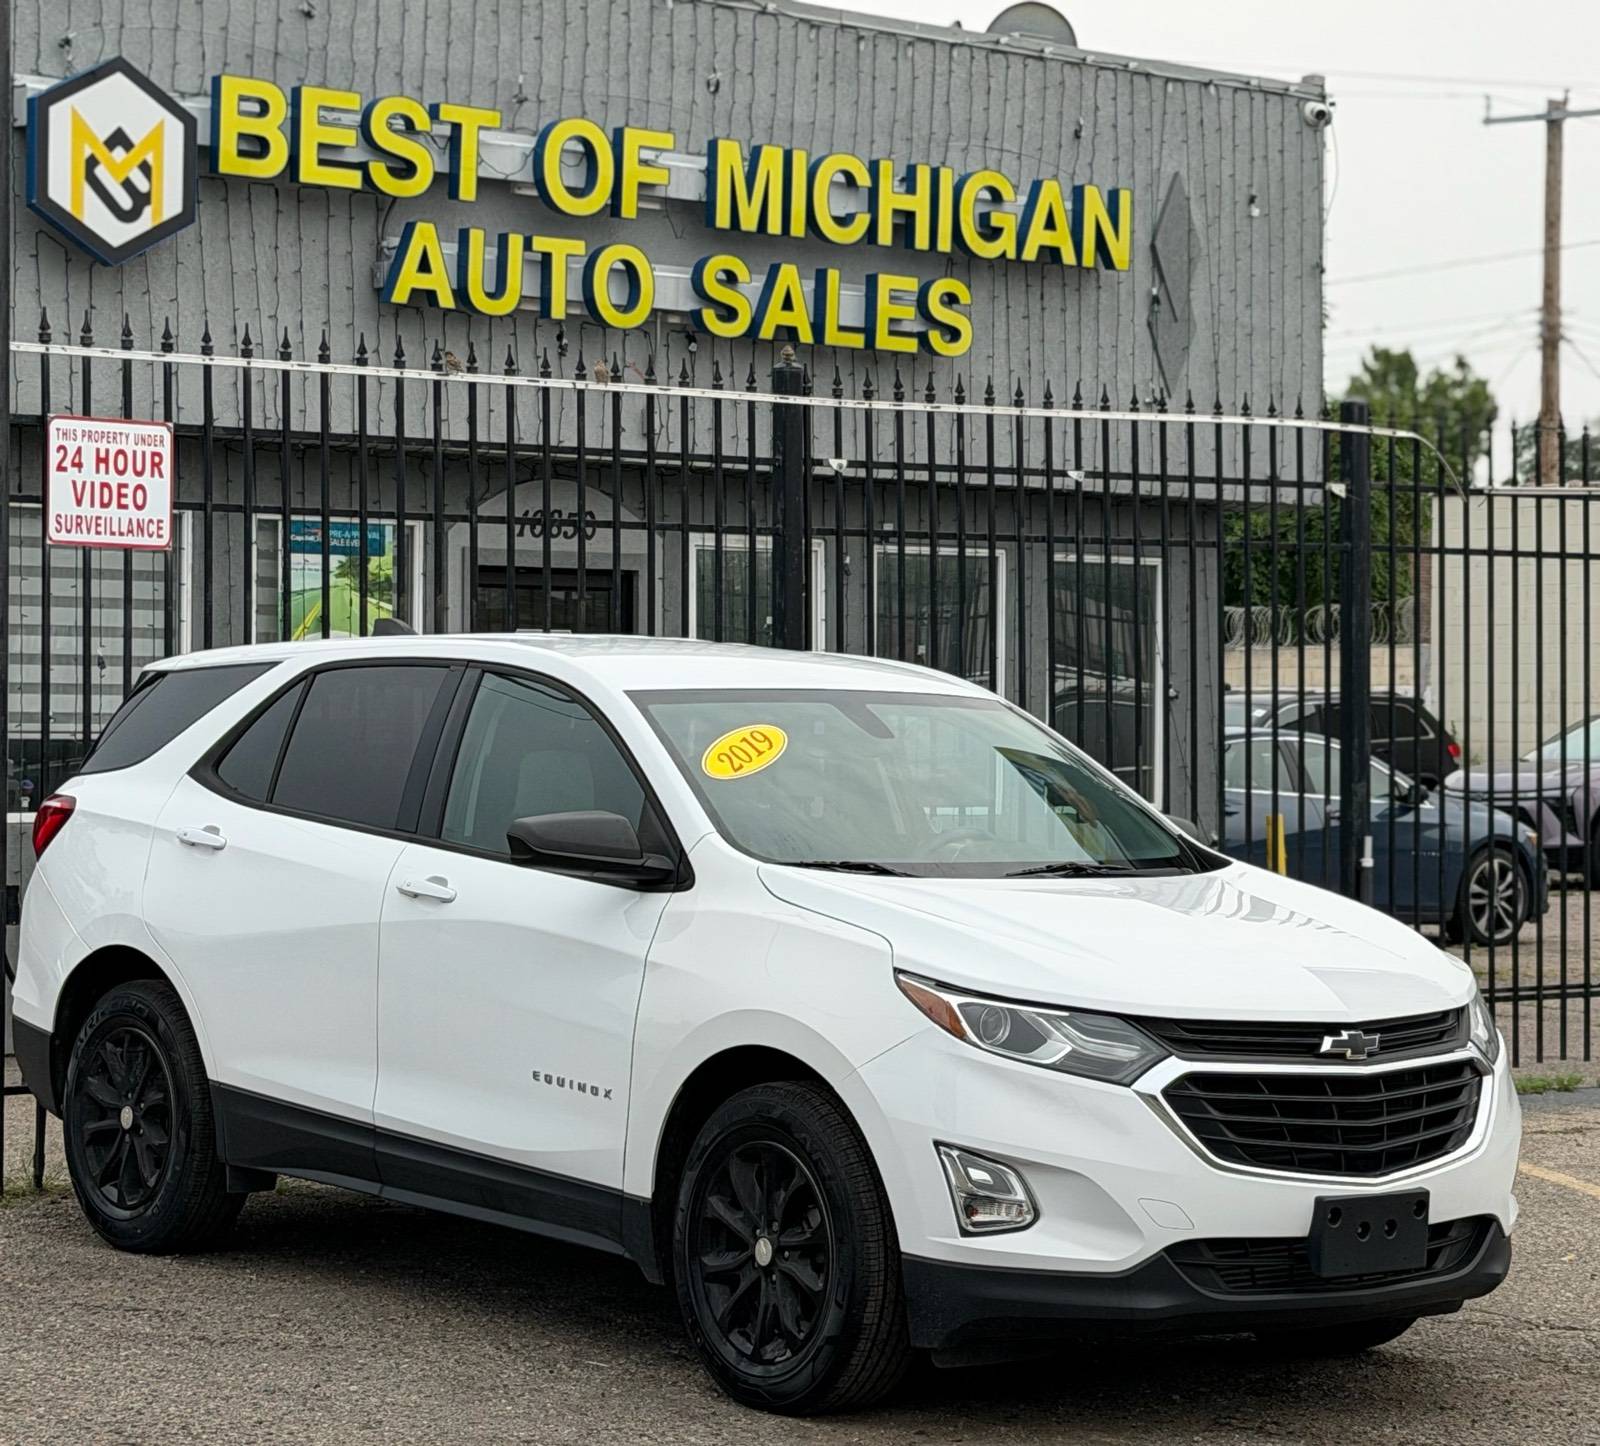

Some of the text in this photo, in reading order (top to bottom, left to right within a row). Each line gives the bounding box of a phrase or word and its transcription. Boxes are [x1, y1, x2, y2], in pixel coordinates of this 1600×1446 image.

[212, 74, 1132, 271] BEST OF MICHIGAN
[385, 221, 973, 357] AUTO SALES
[55, 427, 165, 447] THIS PROPERTY UNDER
[55, 444, 165, 479] 24 HOUR
[71, 479, 148, 511] VIDEO
[54, 513, 165, 539] SURVEILLANCE
[717, 730, 774, 773] 2019
[532, 1070, 613, 1101] EQUINOX
